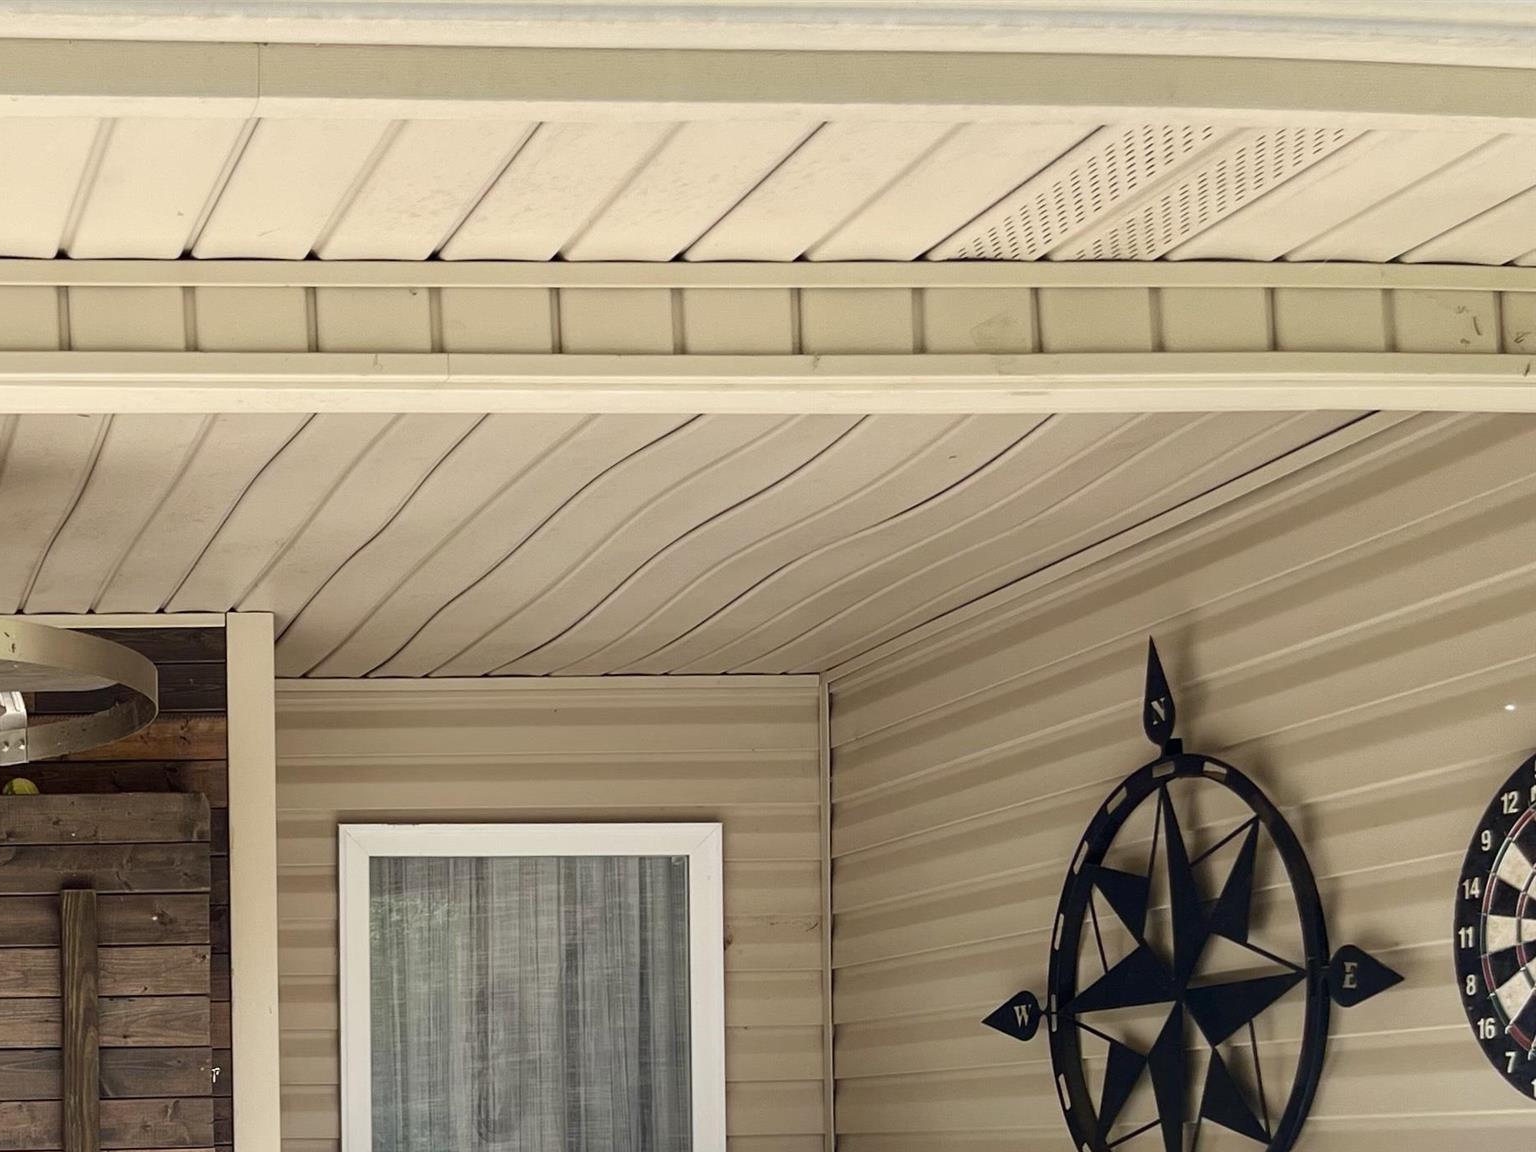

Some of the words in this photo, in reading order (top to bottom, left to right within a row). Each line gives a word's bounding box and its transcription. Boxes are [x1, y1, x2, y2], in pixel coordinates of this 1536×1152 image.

[1150, 697, 1166, 726] N
[1500, 790, 1519, 815] 12
[1481, 829, 1492, 851] 9
[1462, 877, 1480, 899] 14
[1458, 926, 1474, 949] 11
[1465, 974, 1477, 996] 8
[1013, 1003, 1033, 1028] W
[1477, 1017, 1496, 1040] 16
[1505, 1051, 1516, 1074] 7
